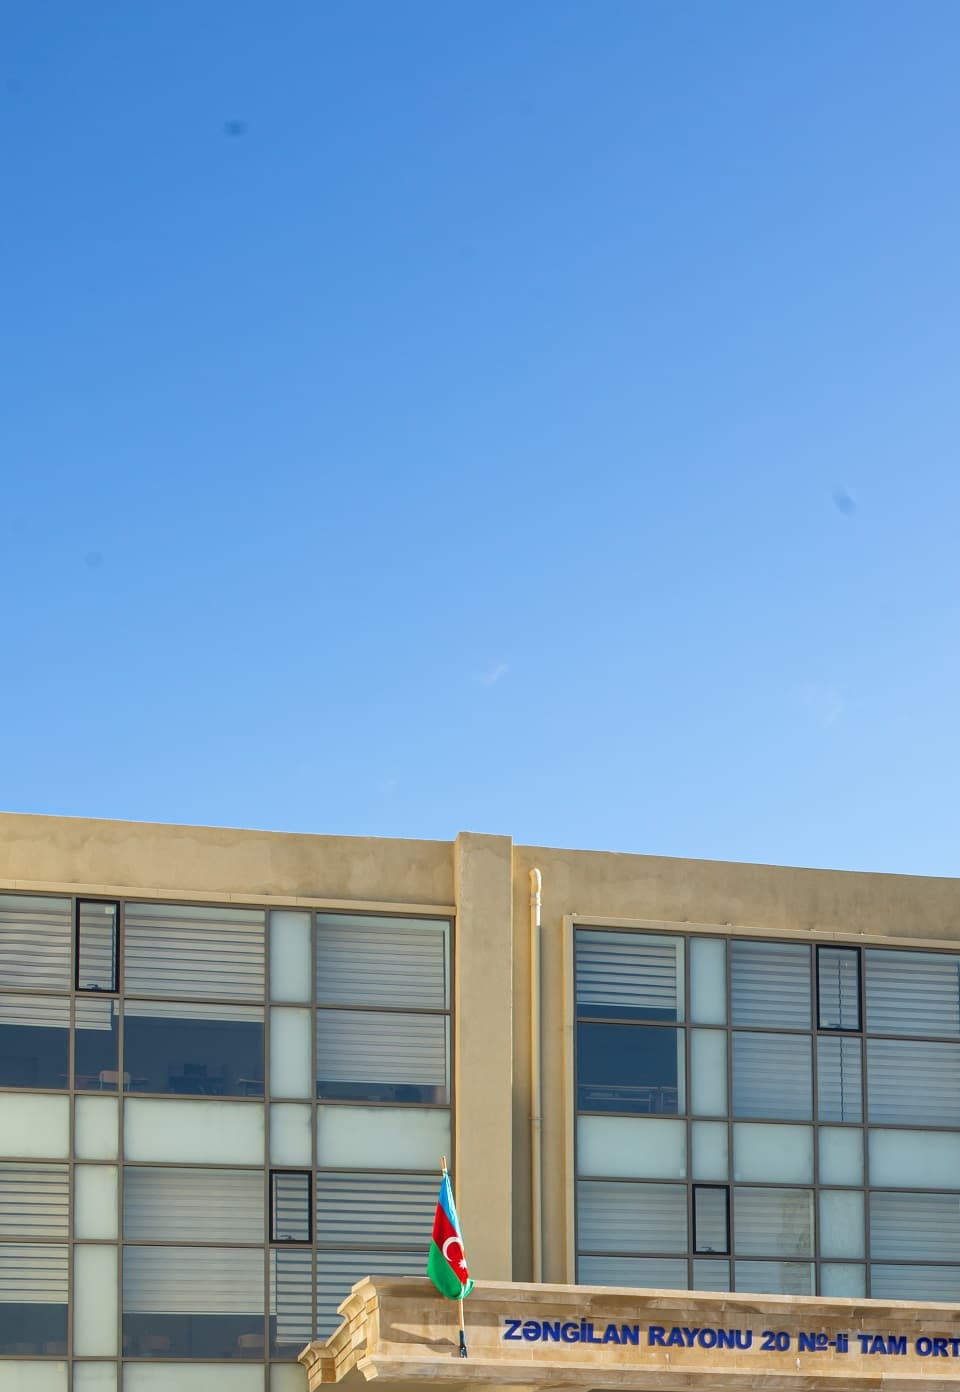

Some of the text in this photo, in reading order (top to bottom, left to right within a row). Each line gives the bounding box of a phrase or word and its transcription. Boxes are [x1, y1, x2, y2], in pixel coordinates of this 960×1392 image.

[504, 1317, 639, 1346] ZƏNGİLAN
[649, 1325, 753, 1350] RAYONU
[760, 1331, 791, 1352] 20
[857, 1334, 908, 1355] TAM
